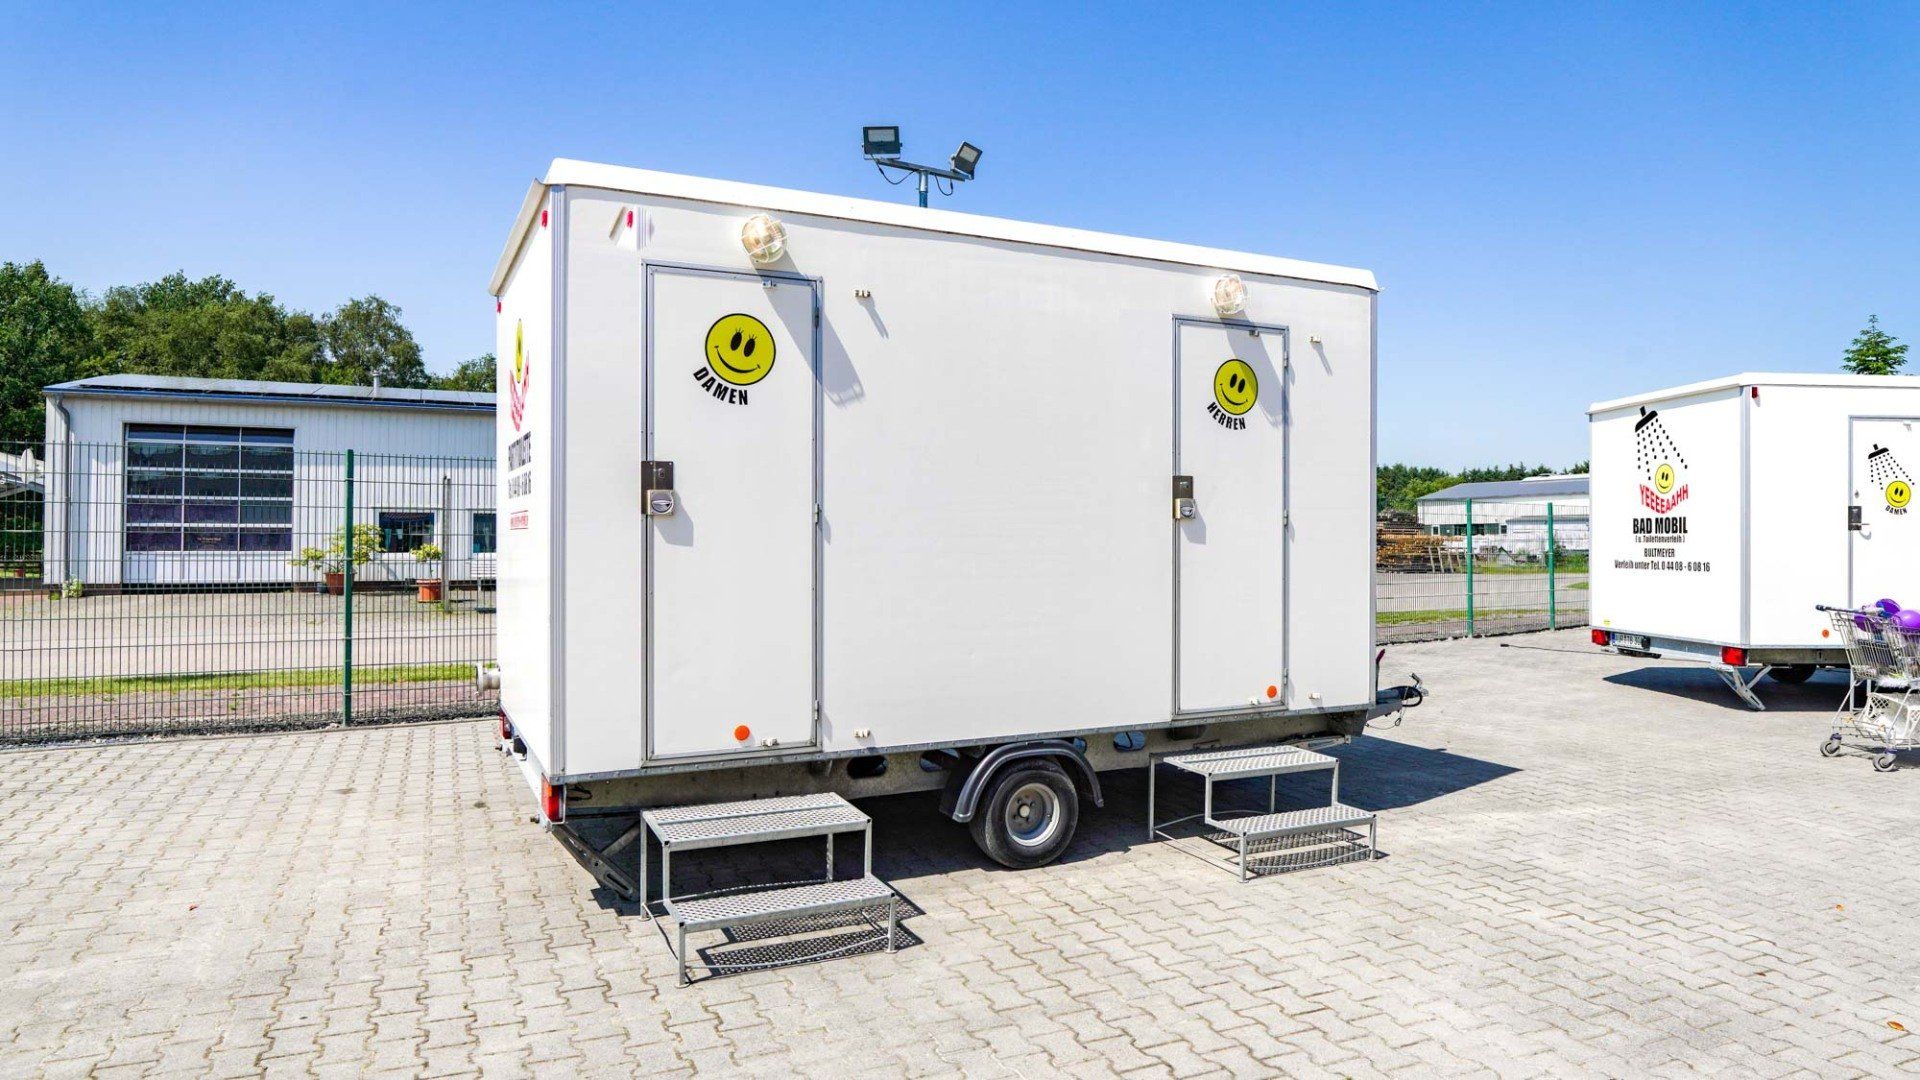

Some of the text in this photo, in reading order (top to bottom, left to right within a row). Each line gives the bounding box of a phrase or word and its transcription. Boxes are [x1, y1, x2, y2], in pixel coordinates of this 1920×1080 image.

[693, 367, 748, 405] DAMEN
[1207, 402, 1246, 430] HERREN
[1640, 484, 1688, 514] YEEEEAAHH
[1885, 505, 1907, 515] DAMEN
[1633, 517, 1688, 534] BAD MOBIL
[1644, 548, 1675, 557] BULTMEYER
[1615, 560, 1634, 569] Verleih
[1635, 561, 1650, 569] unter
